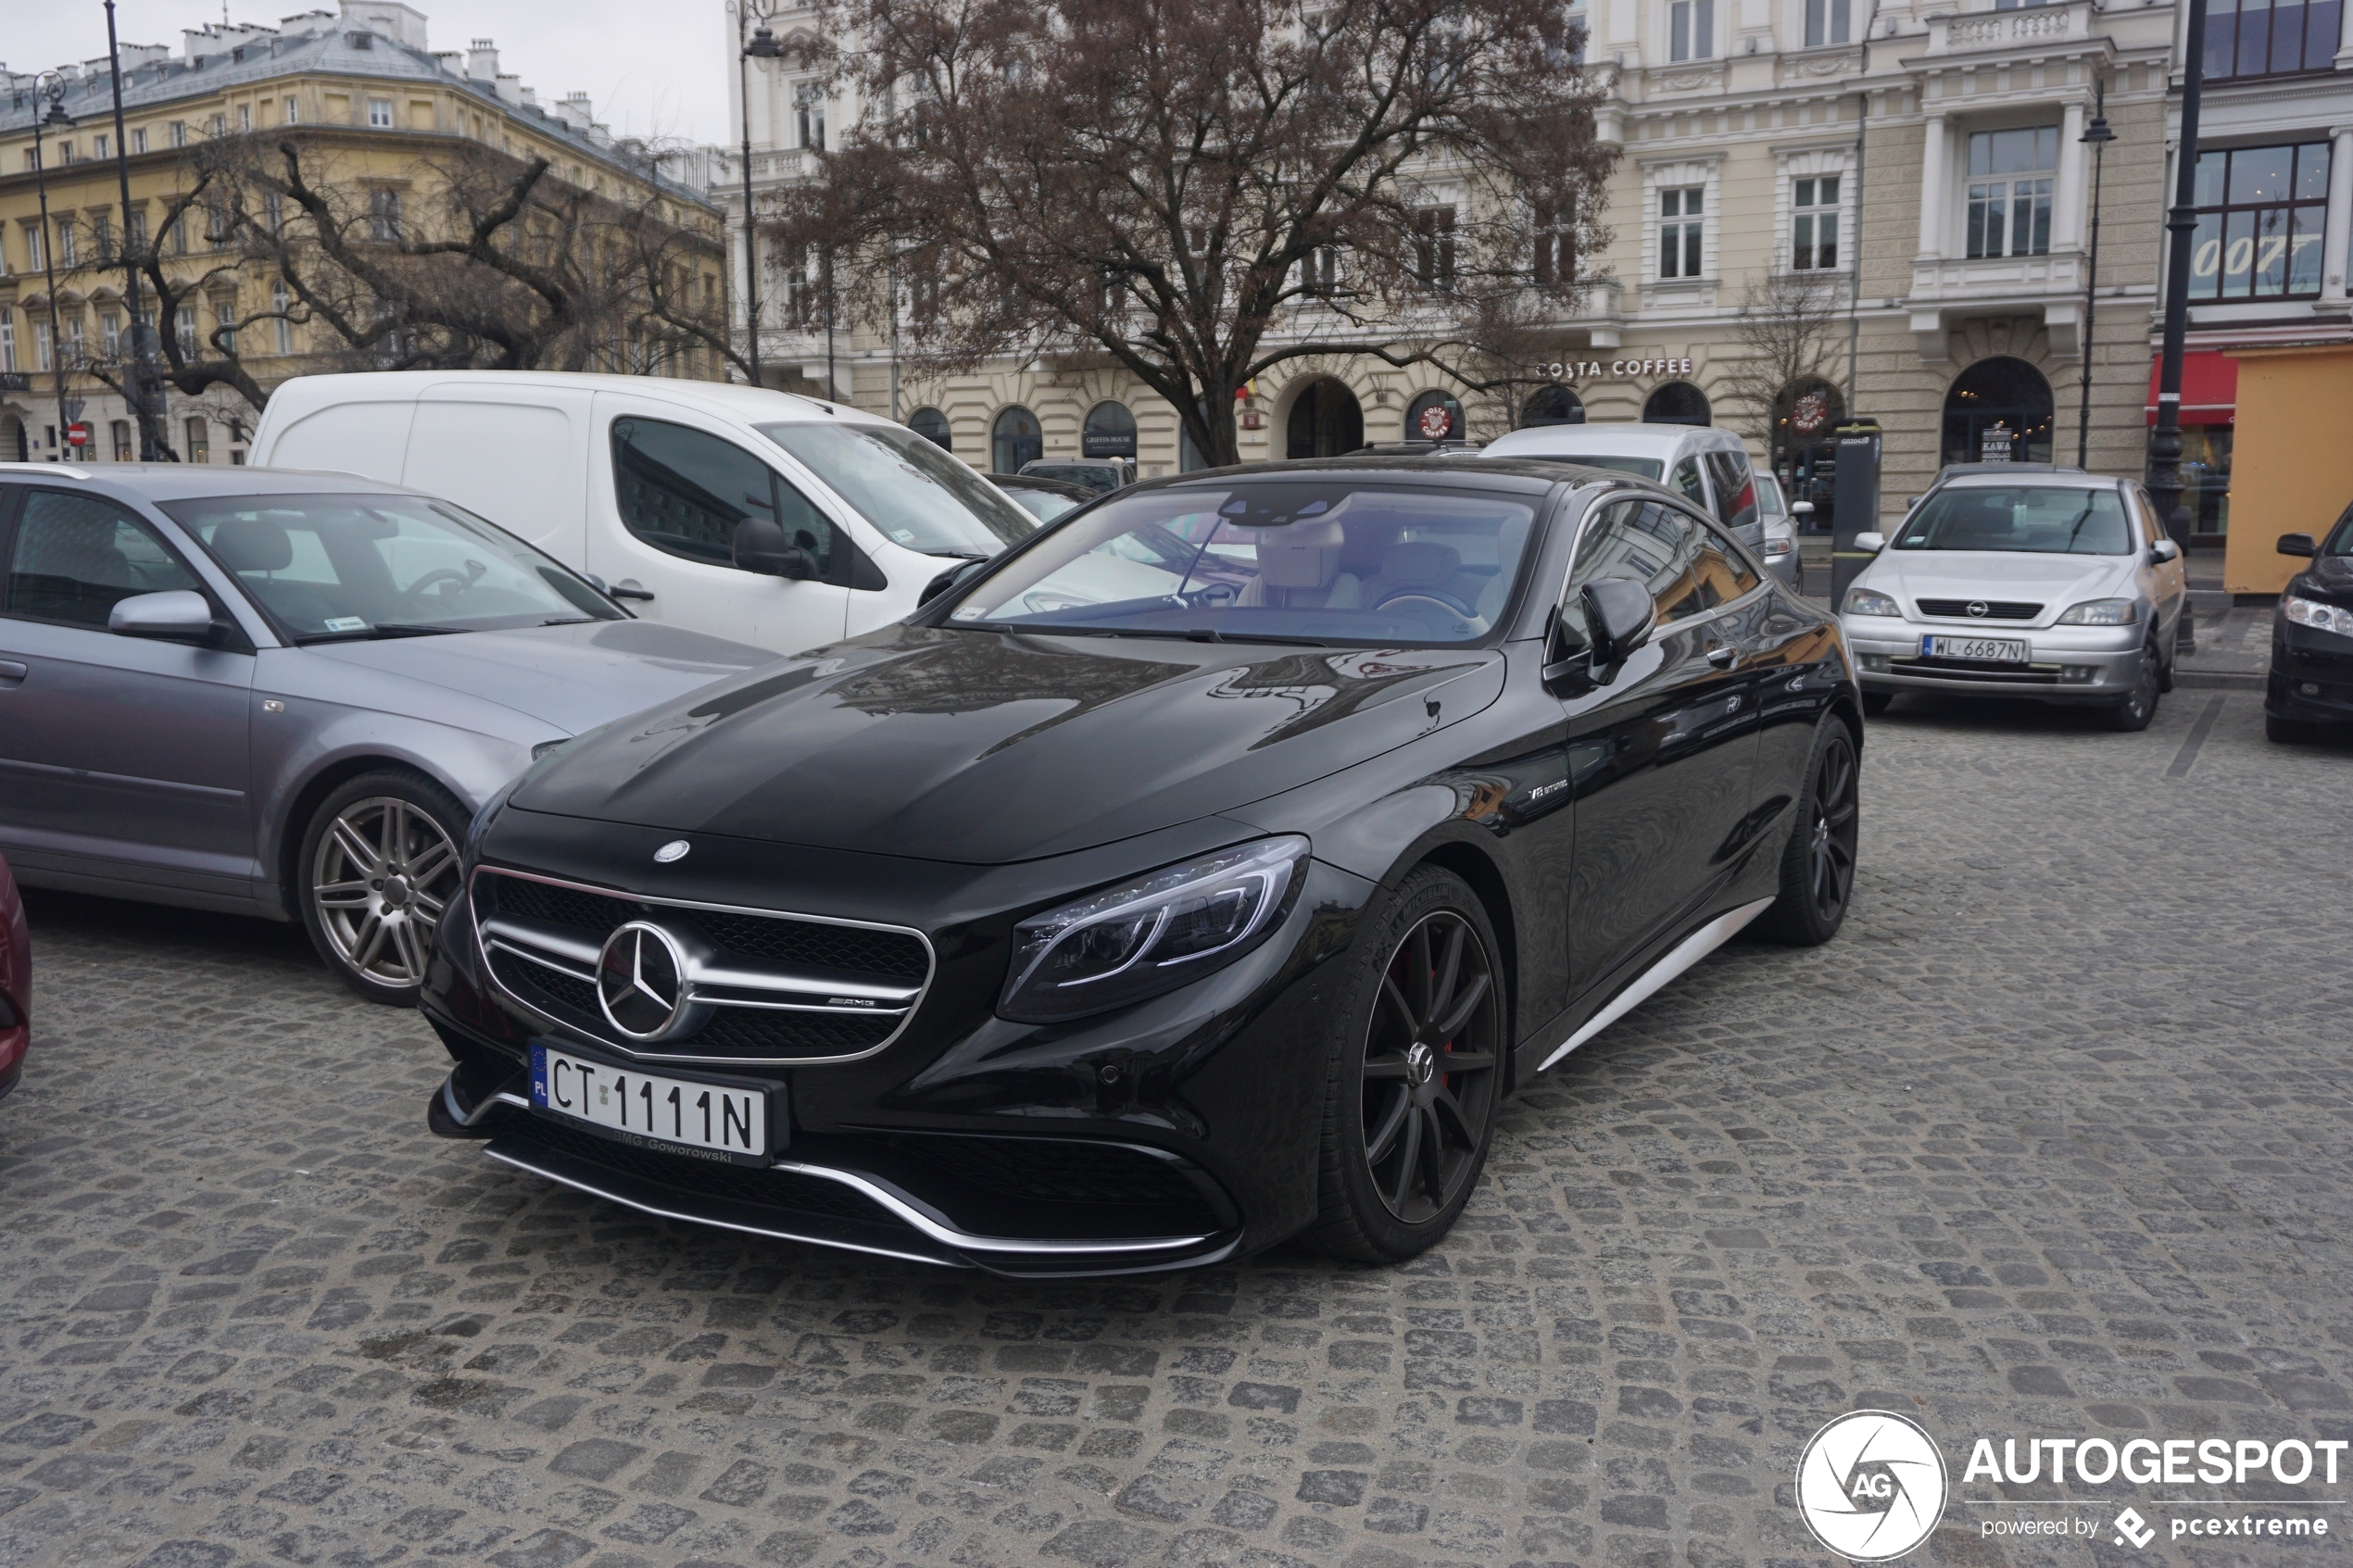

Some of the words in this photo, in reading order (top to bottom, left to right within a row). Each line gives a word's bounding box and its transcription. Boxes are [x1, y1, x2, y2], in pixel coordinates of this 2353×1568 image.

[2193, 236, 2290, 277] 007
[1612, 358, 1692, 376] COFFEE
[1424, 407, 1445, 417] COSTA
[1422, 425, 1448, 436] COFFEE
[1982, 442, 2011, 451] KAWA
[1935, 638, 1957, 656] WL
[1964, 640, 2020, 659] 6687N
[535, 1081, 547, 1097] PL
[553, 1058, 596, 1116] CT
[613, 1074, 751, 1149] 1111N
[648, 1138, 733, 1164] Goworowski
